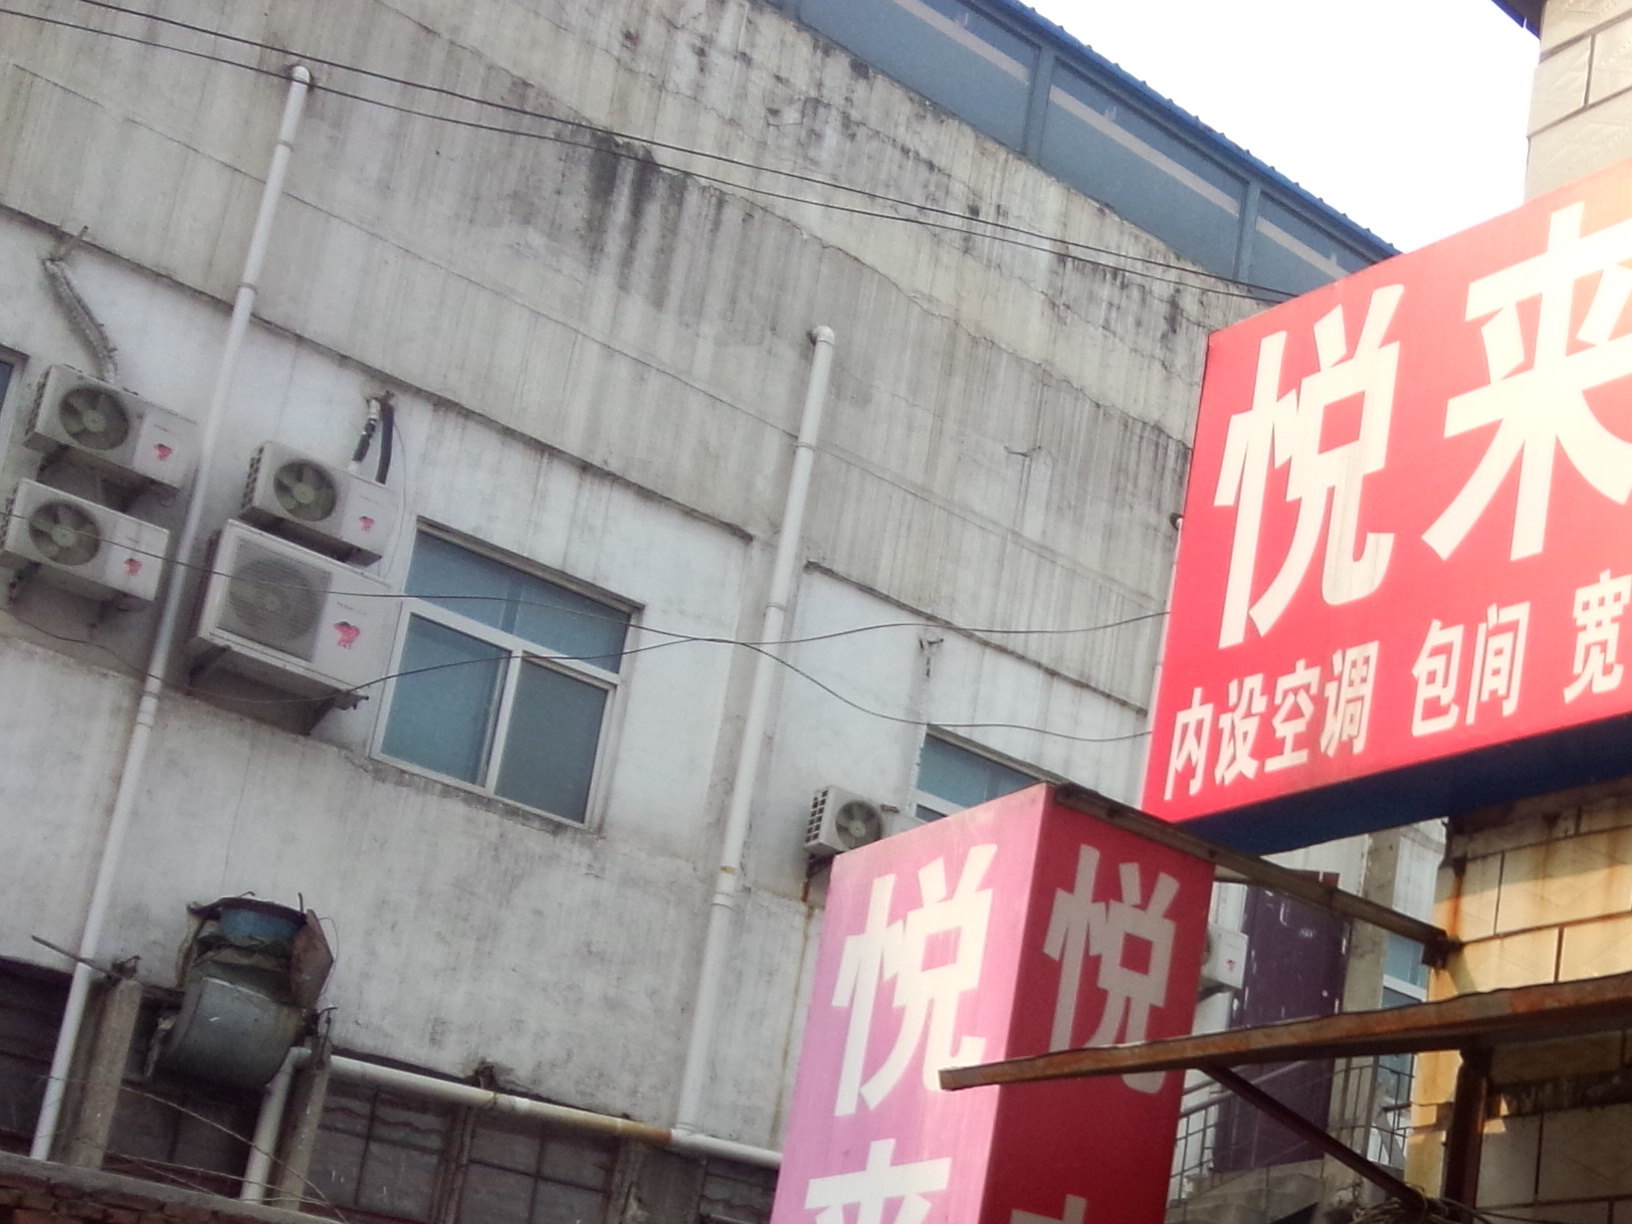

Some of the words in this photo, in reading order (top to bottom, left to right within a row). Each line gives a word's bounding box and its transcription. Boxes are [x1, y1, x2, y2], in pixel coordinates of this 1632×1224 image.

[1164, 642, 1380, 800] 内设空调
[1411, 602, 1530, 736] 包间
